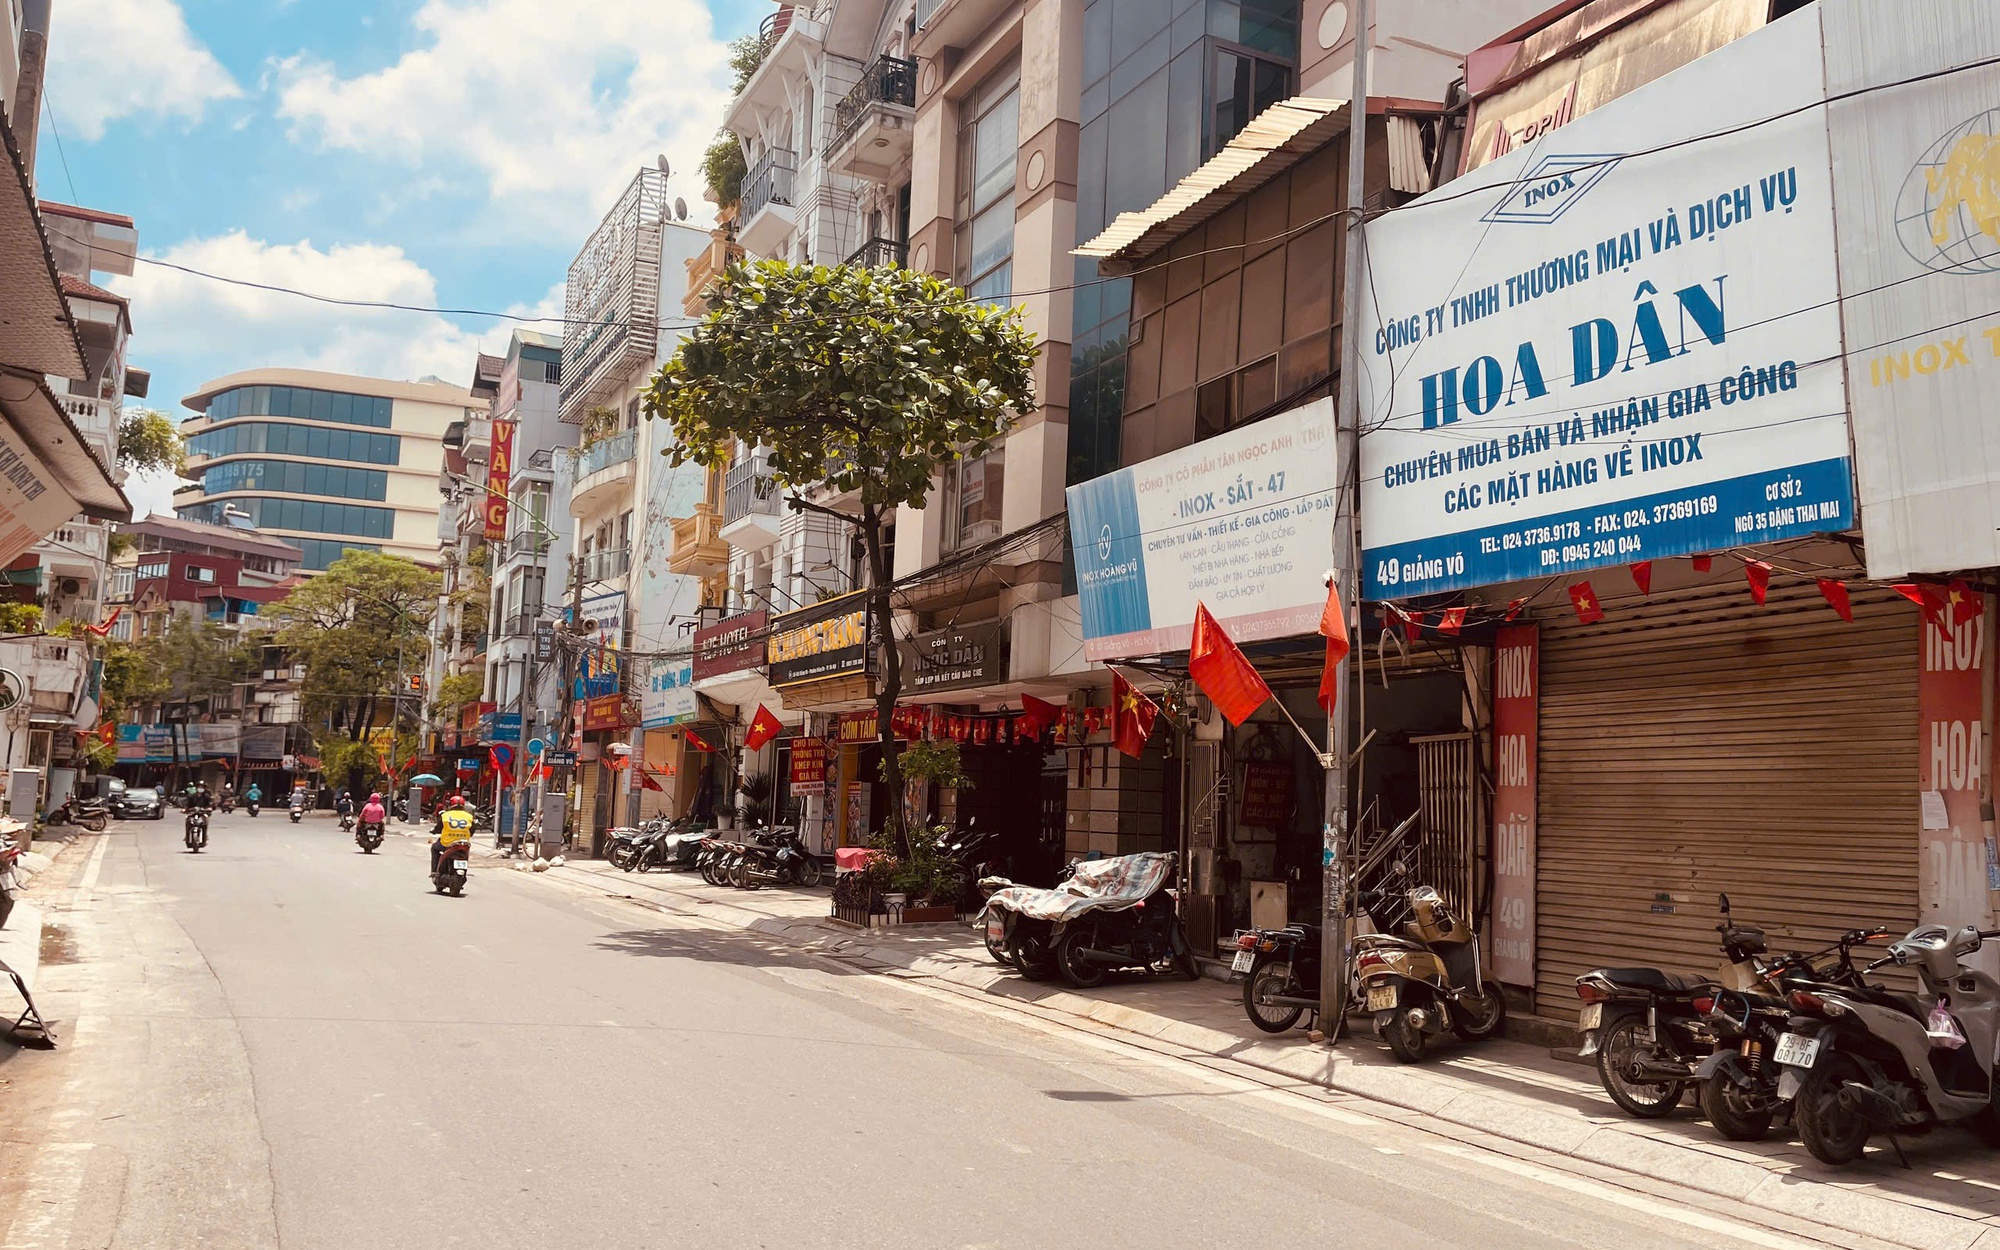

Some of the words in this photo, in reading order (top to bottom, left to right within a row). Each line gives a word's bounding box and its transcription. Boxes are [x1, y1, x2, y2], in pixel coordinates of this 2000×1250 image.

[1524, 171, 1575, 208] INOX
[1376, 313, 1421, 355] CÔNG
[1426, 303, 1445, 337] TY
[1450, 283, 1500, 328] TNHH
[1505, 249, 1589, 308] THƯƠNG
[1596, 227, 1641, 274] MẠI
[1649, 207, 1682, 254] VÀ
[1689, 184, 1752, 242] DỊCH
[1760, 166, 1797, 214] VỤ
[1418, 341, 1550, 432] HOA
[1568, 274, 1728, 388] DÂN
[1870, 335, 1970, 388] INOX
[1384, 450, 1452, 489] CHUYÊN
[1458, 438, 1502, 472] MUA
[1507, 424, 1550, 460] BÁN
[1556, 412, 1586, 446] VÀ
[1592, 396, 1659, 439] NHẬN
[1668, 383, 1711, 419] GIA
[1719, 360, 1798, 406] CÔNG
[1217, 452, 1236, 468] TÂN
[1237, 442, 1269, 462] NGỌC
[1270, 434, 1294, 451] ANH
[487, 421, 512, 526] VÀNG
[1444, 482, 1482, 513] CÁC
[1488, 470, 1530, 507] MẶT
[1537, 459, 1598, 495] HÀNG
[1604, 439, 1633, 480] VỀ
[1641, 431, 1703, 472] INOX
[1765, 483, 1780, 501] CƠ
[1780, 473, 1793, 499] SỞ
[1795, 479, 1802, 496] 2
[1179, 491, 1216, 519] INOX
[1226, 473, 1255, 506] SẮT
[1267, 471, 1286, 494] 47
[1148, 534, 1175, 552] CHUYÊN
[1176, 533, 1186, 544] TƯ
[1187, 527, 1204, 543] VẤN
[1208, 519, 1228, 538] THIẾT
[1229, 517, 1240, 531] KẾ
[1245, 515, 1262, 528] GIA
[1262, 507, 1290, 524] CÔNG
[1480, 538, 1501, 554] TEL:
[1502, 532, 1522, 550] 024
[1524, 520, 1581, 547] 3736.9178
[1594, 513, 1621, 534] FAX:
[1623, 509, 1650, 530] 024.
[1653, 494, 1718, 524] 37369169
[1735, 511, 1754, 533] NGÕ
[1755, 514, 1767, 530] 35
[1769, 508, 1795, 532] ĐẶNG
[1796, 505, 1818, 523] THAI
[1820, 500, 1840, 518] MAI
[484, 528, 506, 540] 9999
[1541, 549, 1560, 566] DĐ:
[1562, 543, 1590, 563] 0945
[1593, 540, 1615, 558] 240
[1618, 534, 1642, 554] 044
[1082, 568, 1099, 583] INOX
[1100, 562, 1126, 580] HOÀNG
[1127, 558, 1138, 572] VŨ
[1376, 557, 1400, 586] 49
[1402, 554, 1443, 583] GIẢNG
[1446, 552, 1465, 576] VÕ
[954, 635, 964, 643] TY
[912, 650, 950, 673] NGỌC
[1497, 645, 1533, 700] INOX
[793, 739, 807, 748] CHO
[841, 720, 858, 740] CƠM
[860, 713, 877, 739] TẤM
[792, 748, 813, 759] PHÒNG
[794, 760, 811, 770] KHÉP
[1499, 734, 1528, 788] HOA
[1931, 720, 1982, 791] HOA
[448, 815, 468, 829] be
[1497, 812, 1528, 878] DÂN
[1500, 896, 1526, 930] 49
[1776, 1048, 1812, 1066] 081.70
[1783, 1036, 1813, 1052] 29-BF
